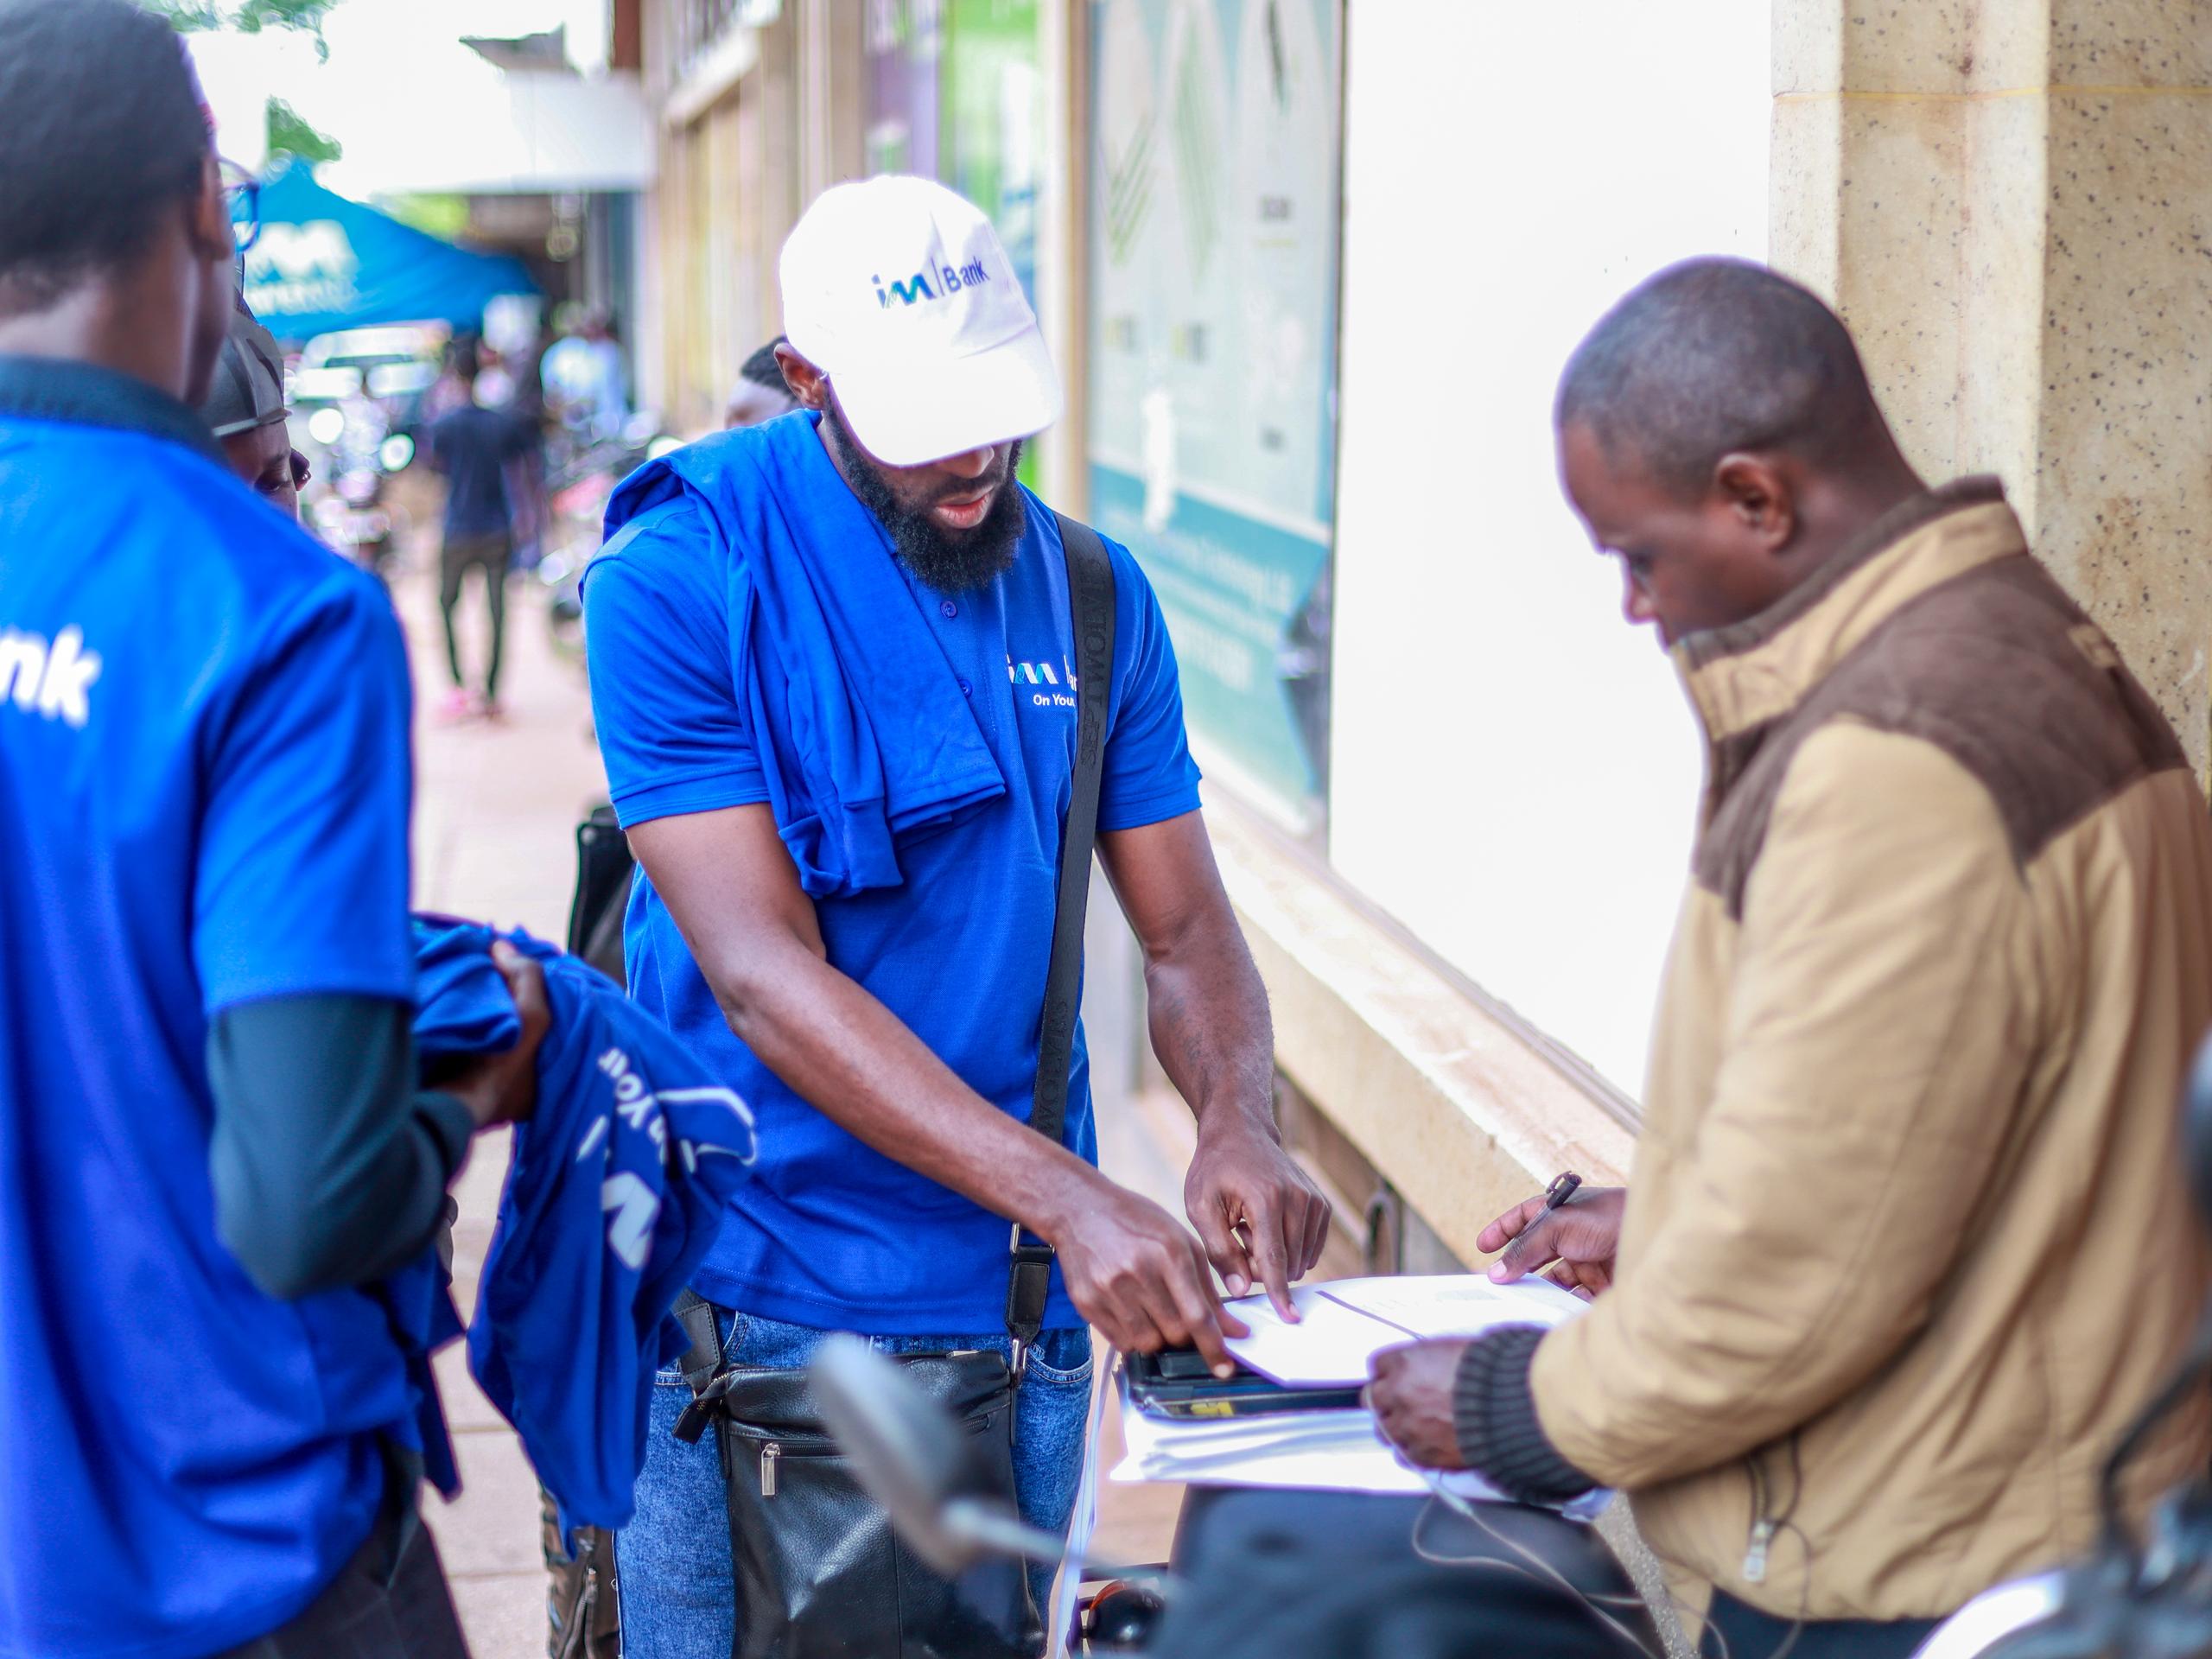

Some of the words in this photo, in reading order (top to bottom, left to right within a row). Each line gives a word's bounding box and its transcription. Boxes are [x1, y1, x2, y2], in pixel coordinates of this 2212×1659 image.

[943, 256, 991, 293] Bank
[0, 625, 103, 730] nk
[1033, 694, 1050, 706] On
[1052, 694, 1076, 707] You
